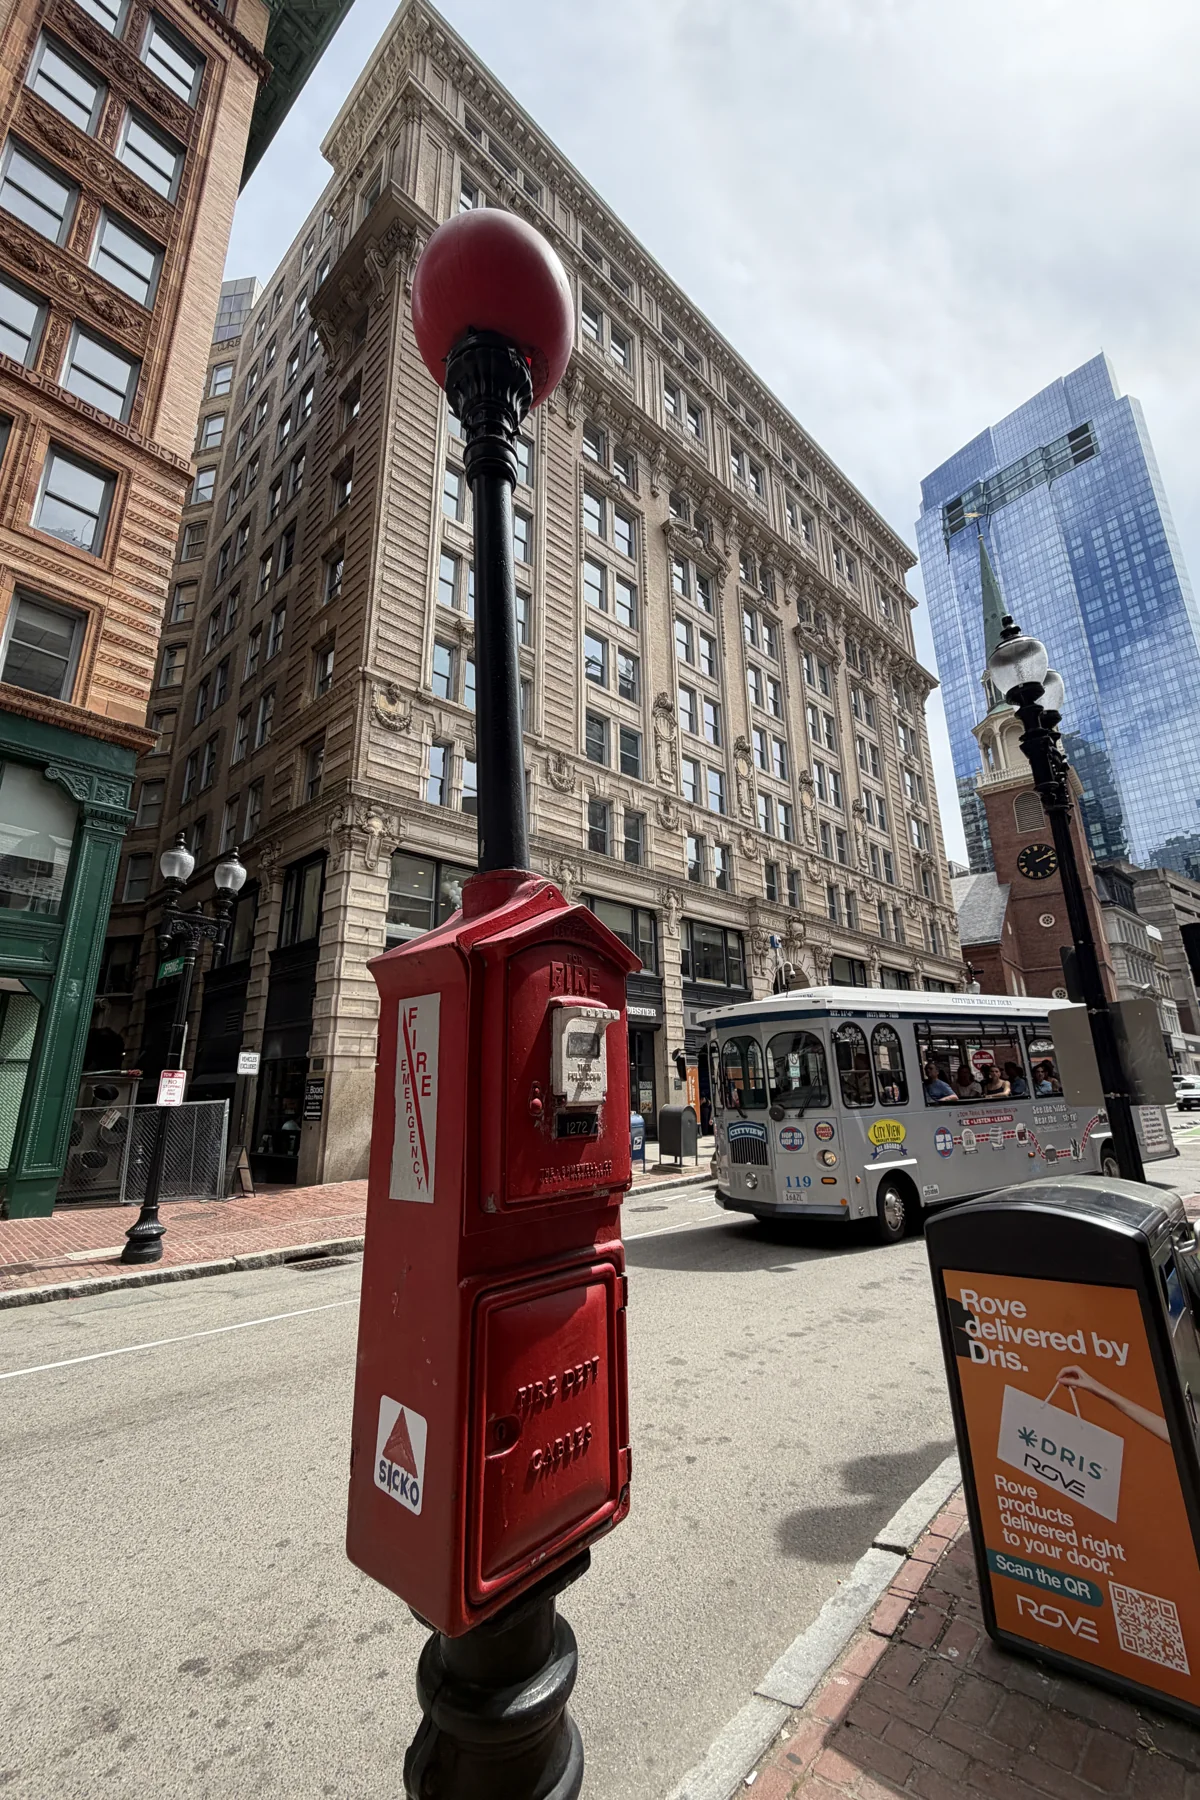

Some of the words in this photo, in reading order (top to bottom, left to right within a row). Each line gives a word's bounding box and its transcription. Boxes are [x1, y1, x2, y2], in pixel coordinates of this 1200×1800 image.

[549, 961, 601, 993] FIRE
[627, 1005, 657, 1017] OBSTER
[407, 1006, 433, 1098] FIRE
[401, 1059, 425, 1191] EMERGENCY
[566, 1121, 588, 1134] 1272
[1032, 1105, 1043, 1114] See
[730, 1126, 764, 1138] CITYVIEW
[873, 1124, 885, 1139] CITY
[885, 1123, 901, 1137] VIEW
[876, 1145, 884, 1153] ALL
[786, 1175, 812, 1188] 119
[960, 1289, 1027, 1319] Rove
[965, 1316, 1086, 1355] delivered
[1093, 1332, 1130, 1367] by
[968, 1340, 1030, 1373] Dris.
[517, 1375, 558, 1409] FIRE
[563, 1355, 601, 1388] DEPT
[531, 1422, 593, 1471] CABLES
[1040, 1439, 1103, 1481] DRIS
[379, 1459, 420, 1508] SICKO
[994, 1474, 1038, 1500] Rove
[1024, 1453, 1086, 1499] ROVE
[997, 1495, 1075, 1528] products
[1000, 1511, 1078, 1549] delivered
[1081, 1531, 1127, 1562] right
[1002, 1528, 1020, 1547] to
[1022, 1538, 1063, 1562] your
[1066, 1548, 1115, 1577] door.
[995, 1555, 1034, 1580] Scan
[1035, 1565, 1062, 1589] the
[1064, 1576, 1092, 1600] QR
[1016, 1594, 1100, 1644] ROVE
